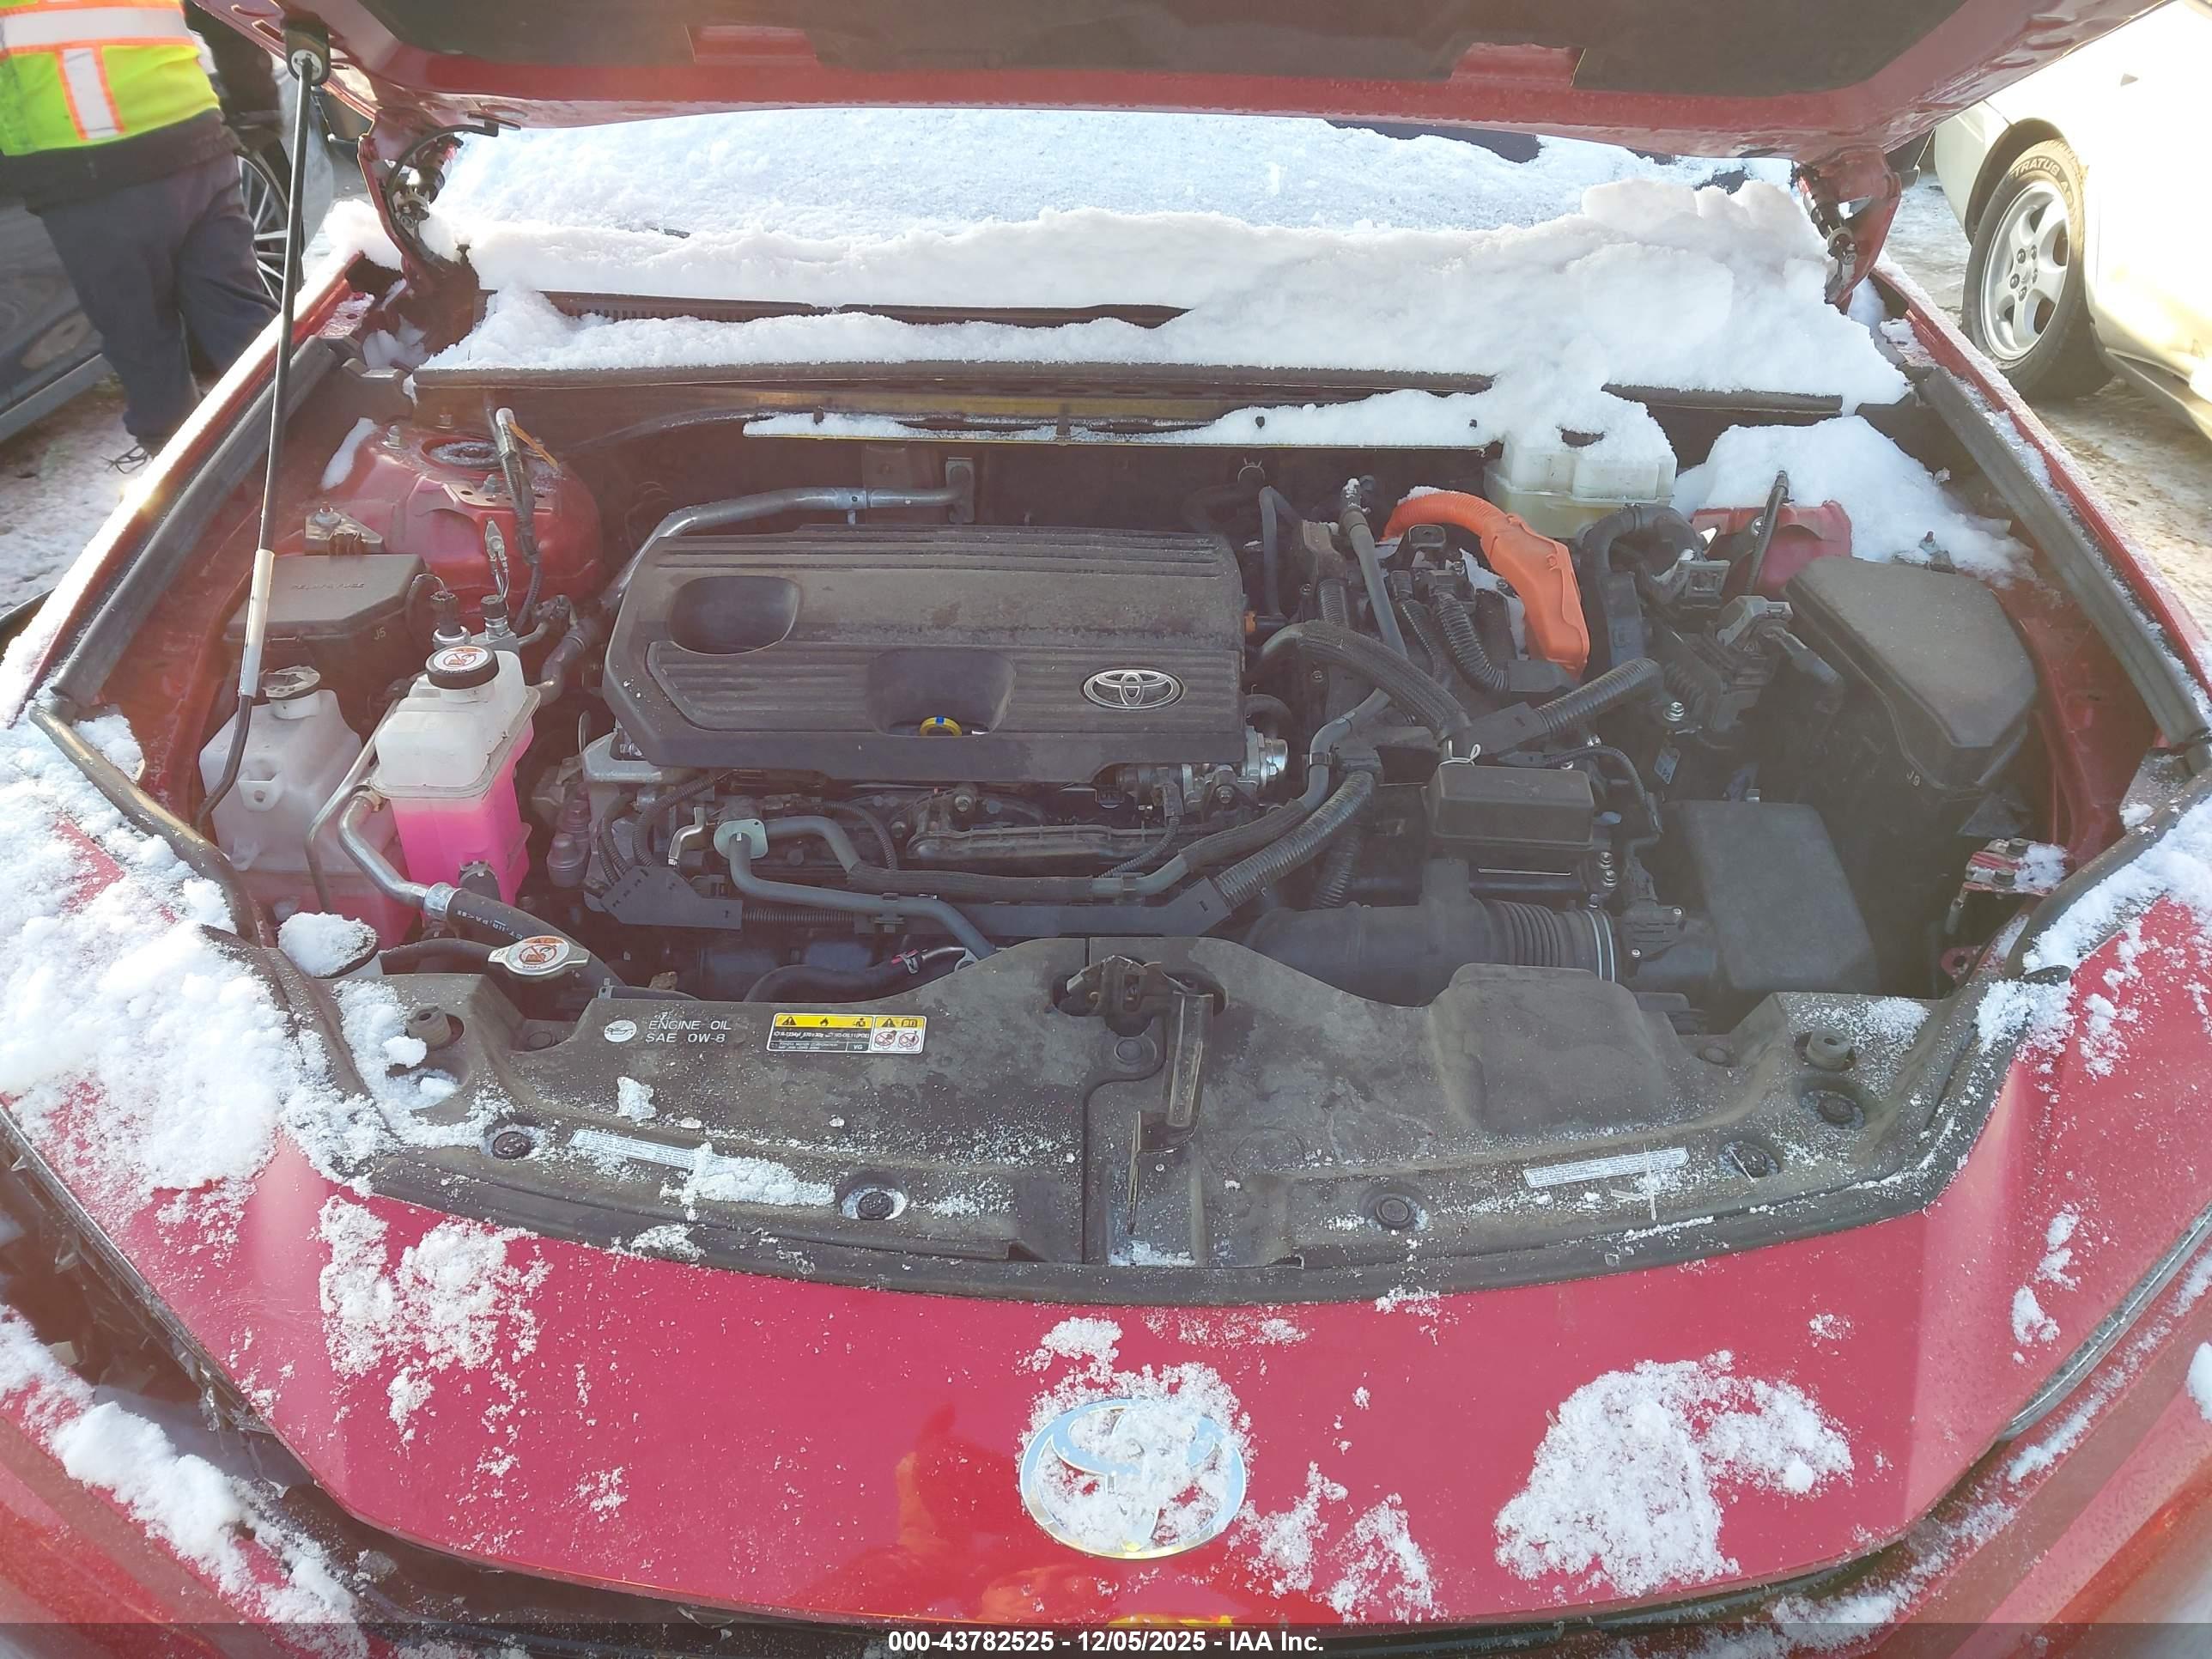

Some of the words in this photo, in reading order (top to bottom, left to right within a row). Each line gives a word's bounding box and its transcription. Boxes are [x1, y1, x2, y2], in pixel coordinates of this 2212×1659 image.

[648, 1020, 701, 1030] ENGINE
[710, 1020, 732, 1030] OIL
[645, 1033, 678, 1042] SAE
[688, 1033, 726, 1043] 0W-8
